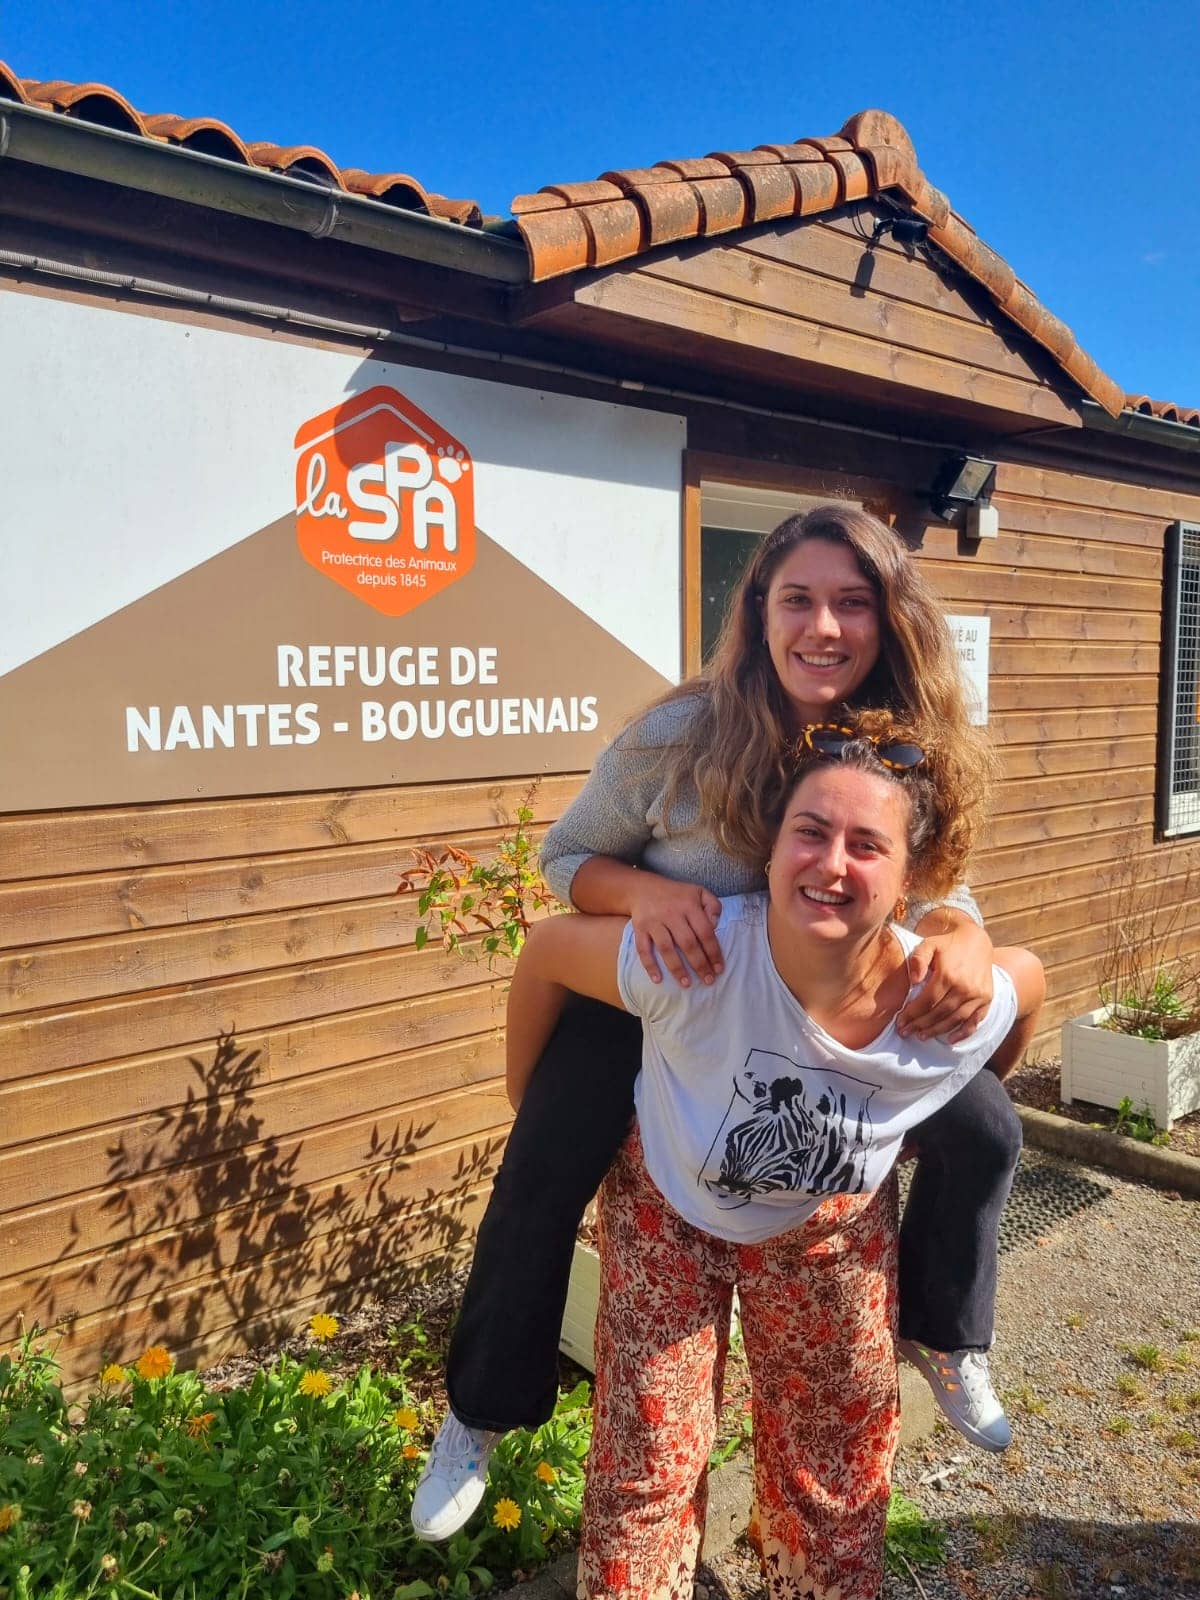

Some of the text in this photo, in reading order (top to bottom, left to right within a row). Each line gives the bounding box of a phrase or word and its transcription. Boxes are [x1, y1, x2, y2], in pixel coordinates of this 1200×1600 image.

[295, 441, 456, 551] la SPA
[321, 551, 457, 572] Protectrice des Animaux
[357, 572, 427, 588] depuis 1845
[965, 629, 978, 643] AU
[277, 644, 498, 687] REFUGE DE
[125, 695, 599, 752] NANTES - BOUGUENAIS
